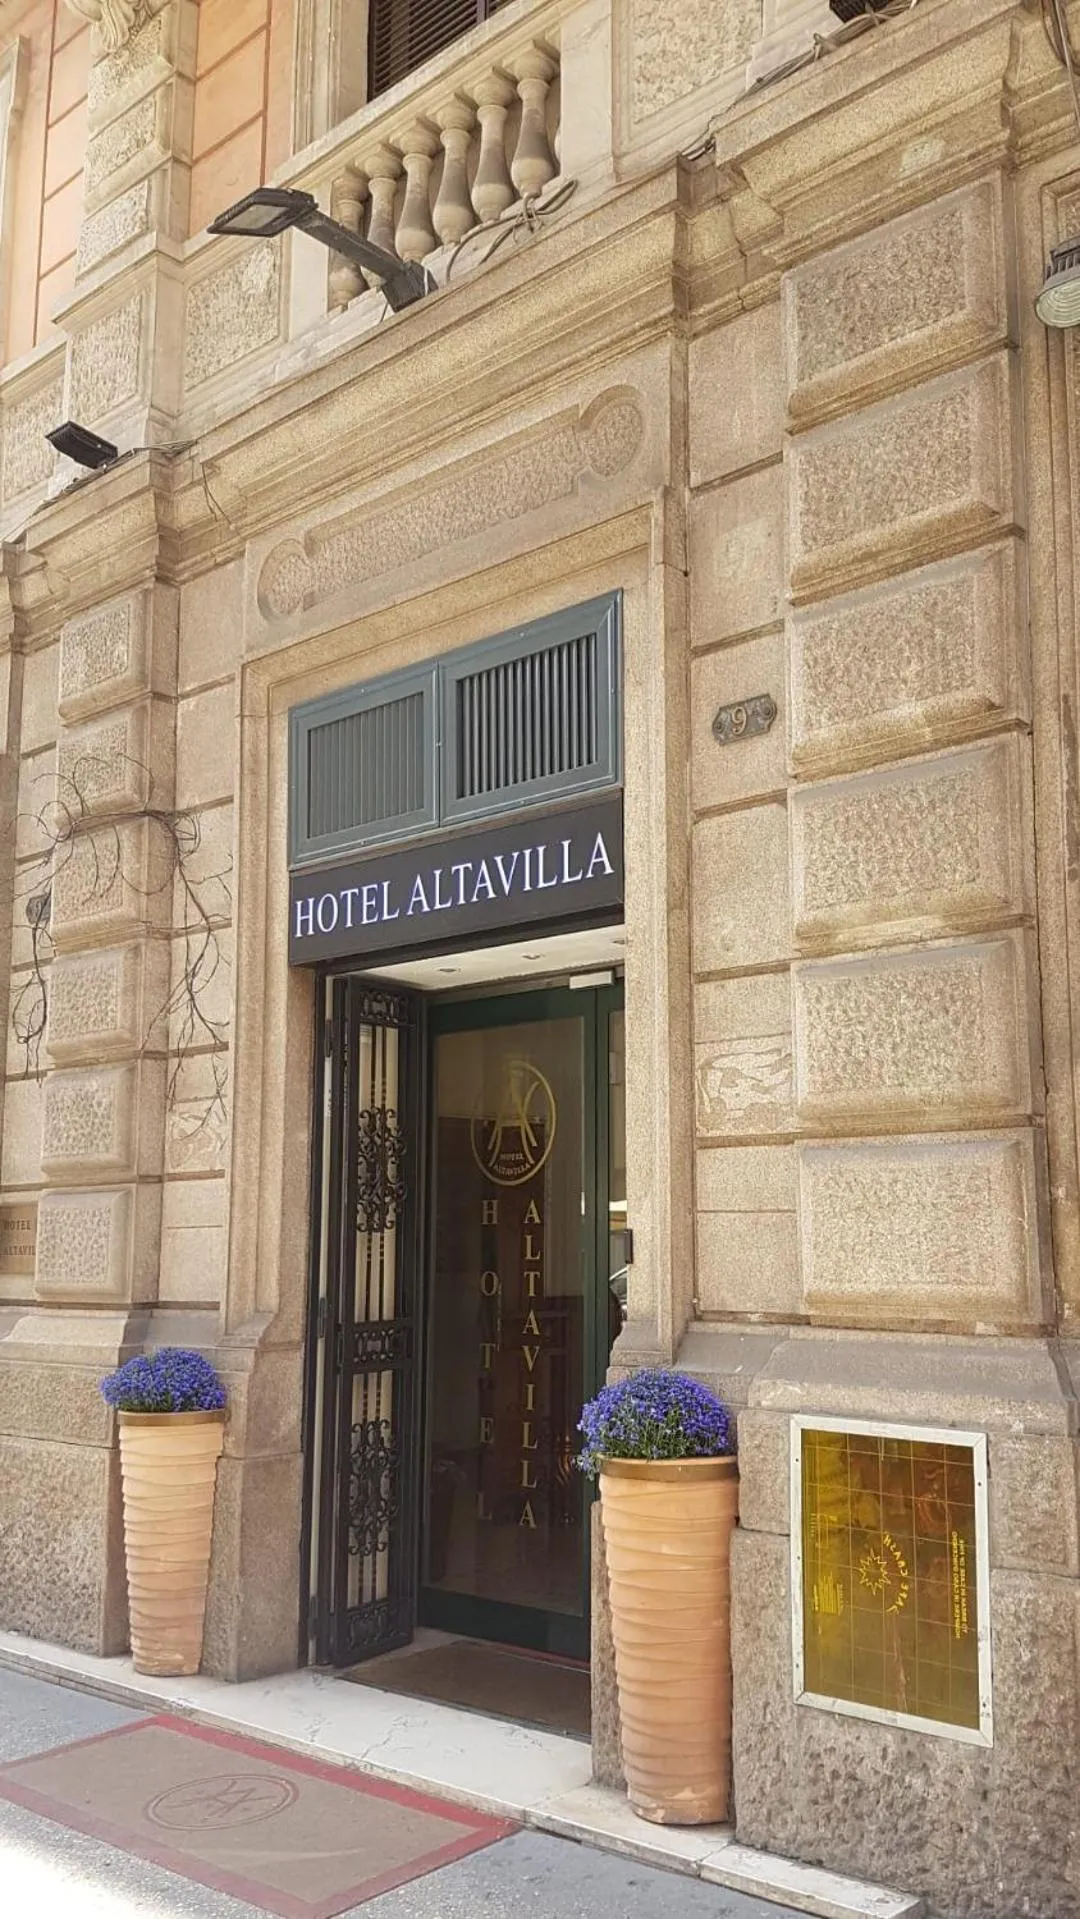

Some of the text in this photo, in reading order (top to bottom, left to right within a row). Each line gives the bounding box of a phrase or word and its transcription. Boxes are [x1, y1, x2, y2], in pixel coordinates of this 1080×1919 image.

[731, 706, 747, 735] 9
[295, 831, 615, 938] HOTEL ALTAVILLA
[477, 1199, 500, 1521] HOTEL
[518, 1199, 542, 1529] ALTAVILLA
